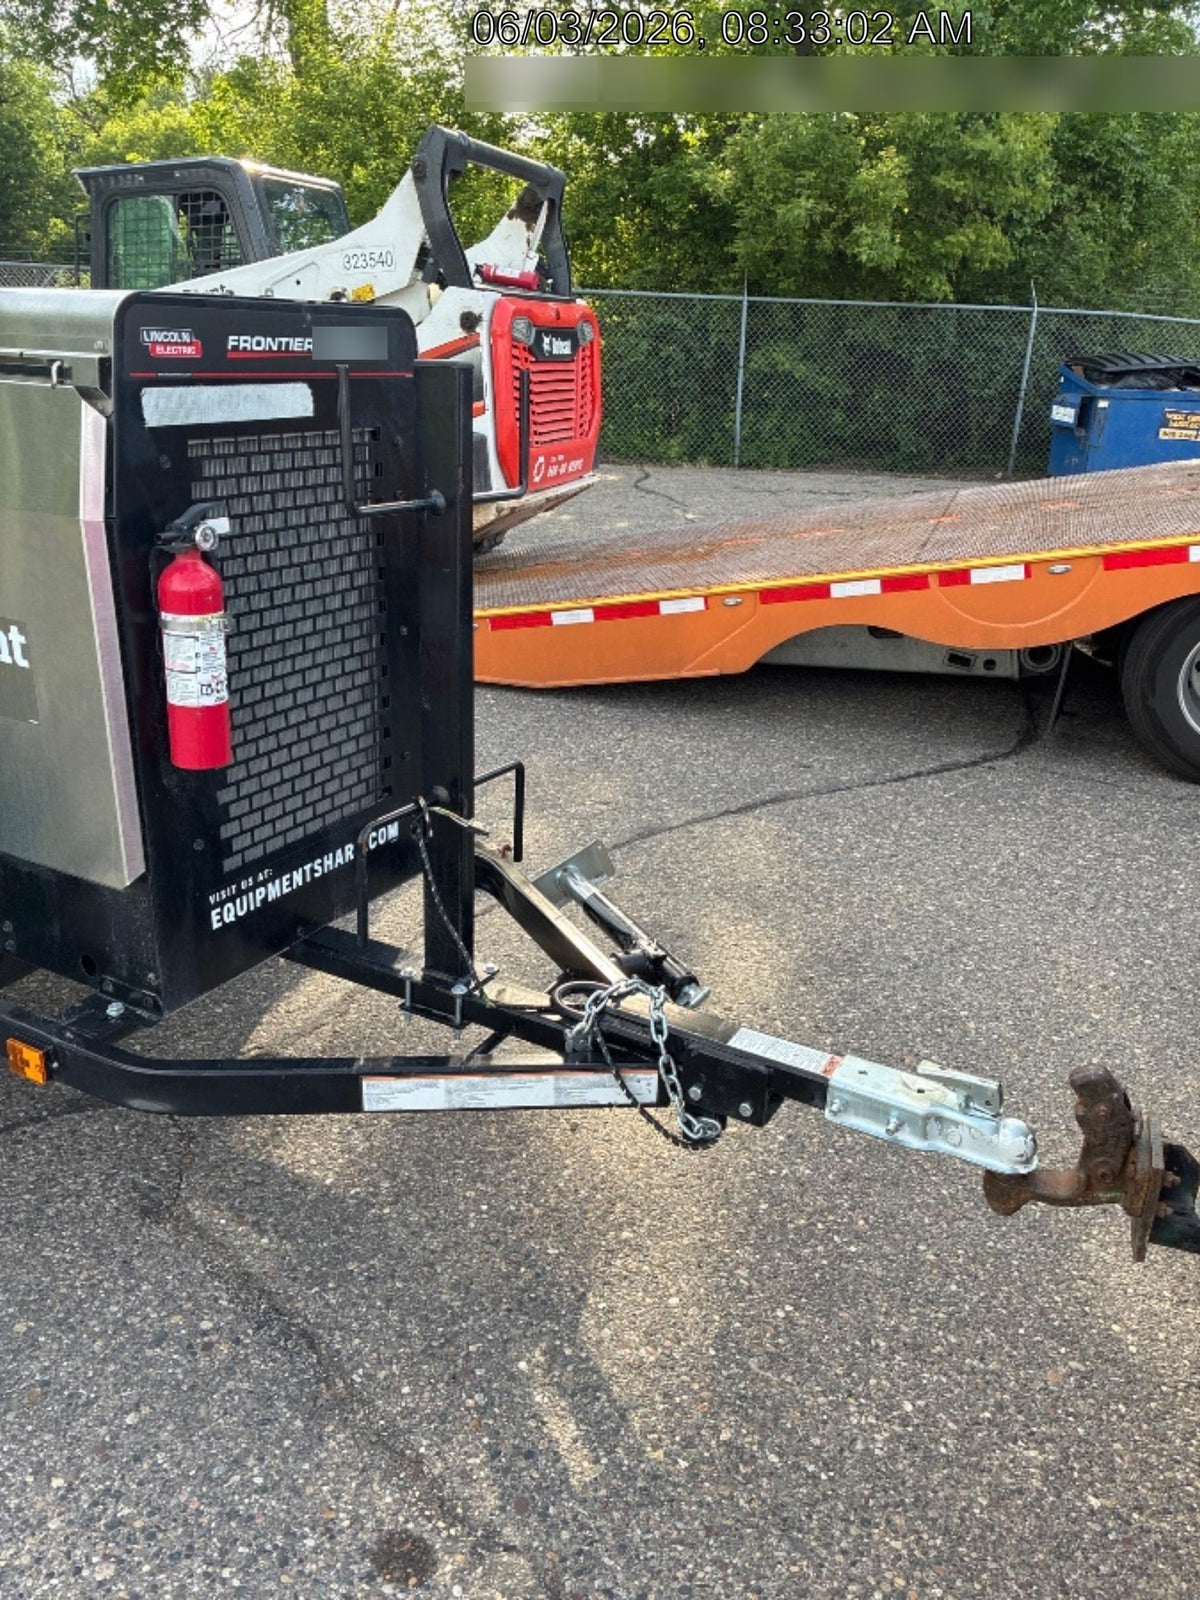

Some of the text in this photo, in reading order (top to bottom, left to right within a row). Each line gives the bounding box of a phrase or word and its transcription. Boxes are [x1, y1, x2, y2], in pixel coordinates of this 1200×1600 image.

[343, 250, 394, 271] 323540
[143, 330, 191, 343] LINCOLN
[227, 335, 313, 351] FRONTIER
[155, 345, 196, 355] ELECTRIC
[210, 821, 399, 930] EQUIPMENTSHARCOM
[209, 868, 273, 905] VISIT US AT:
